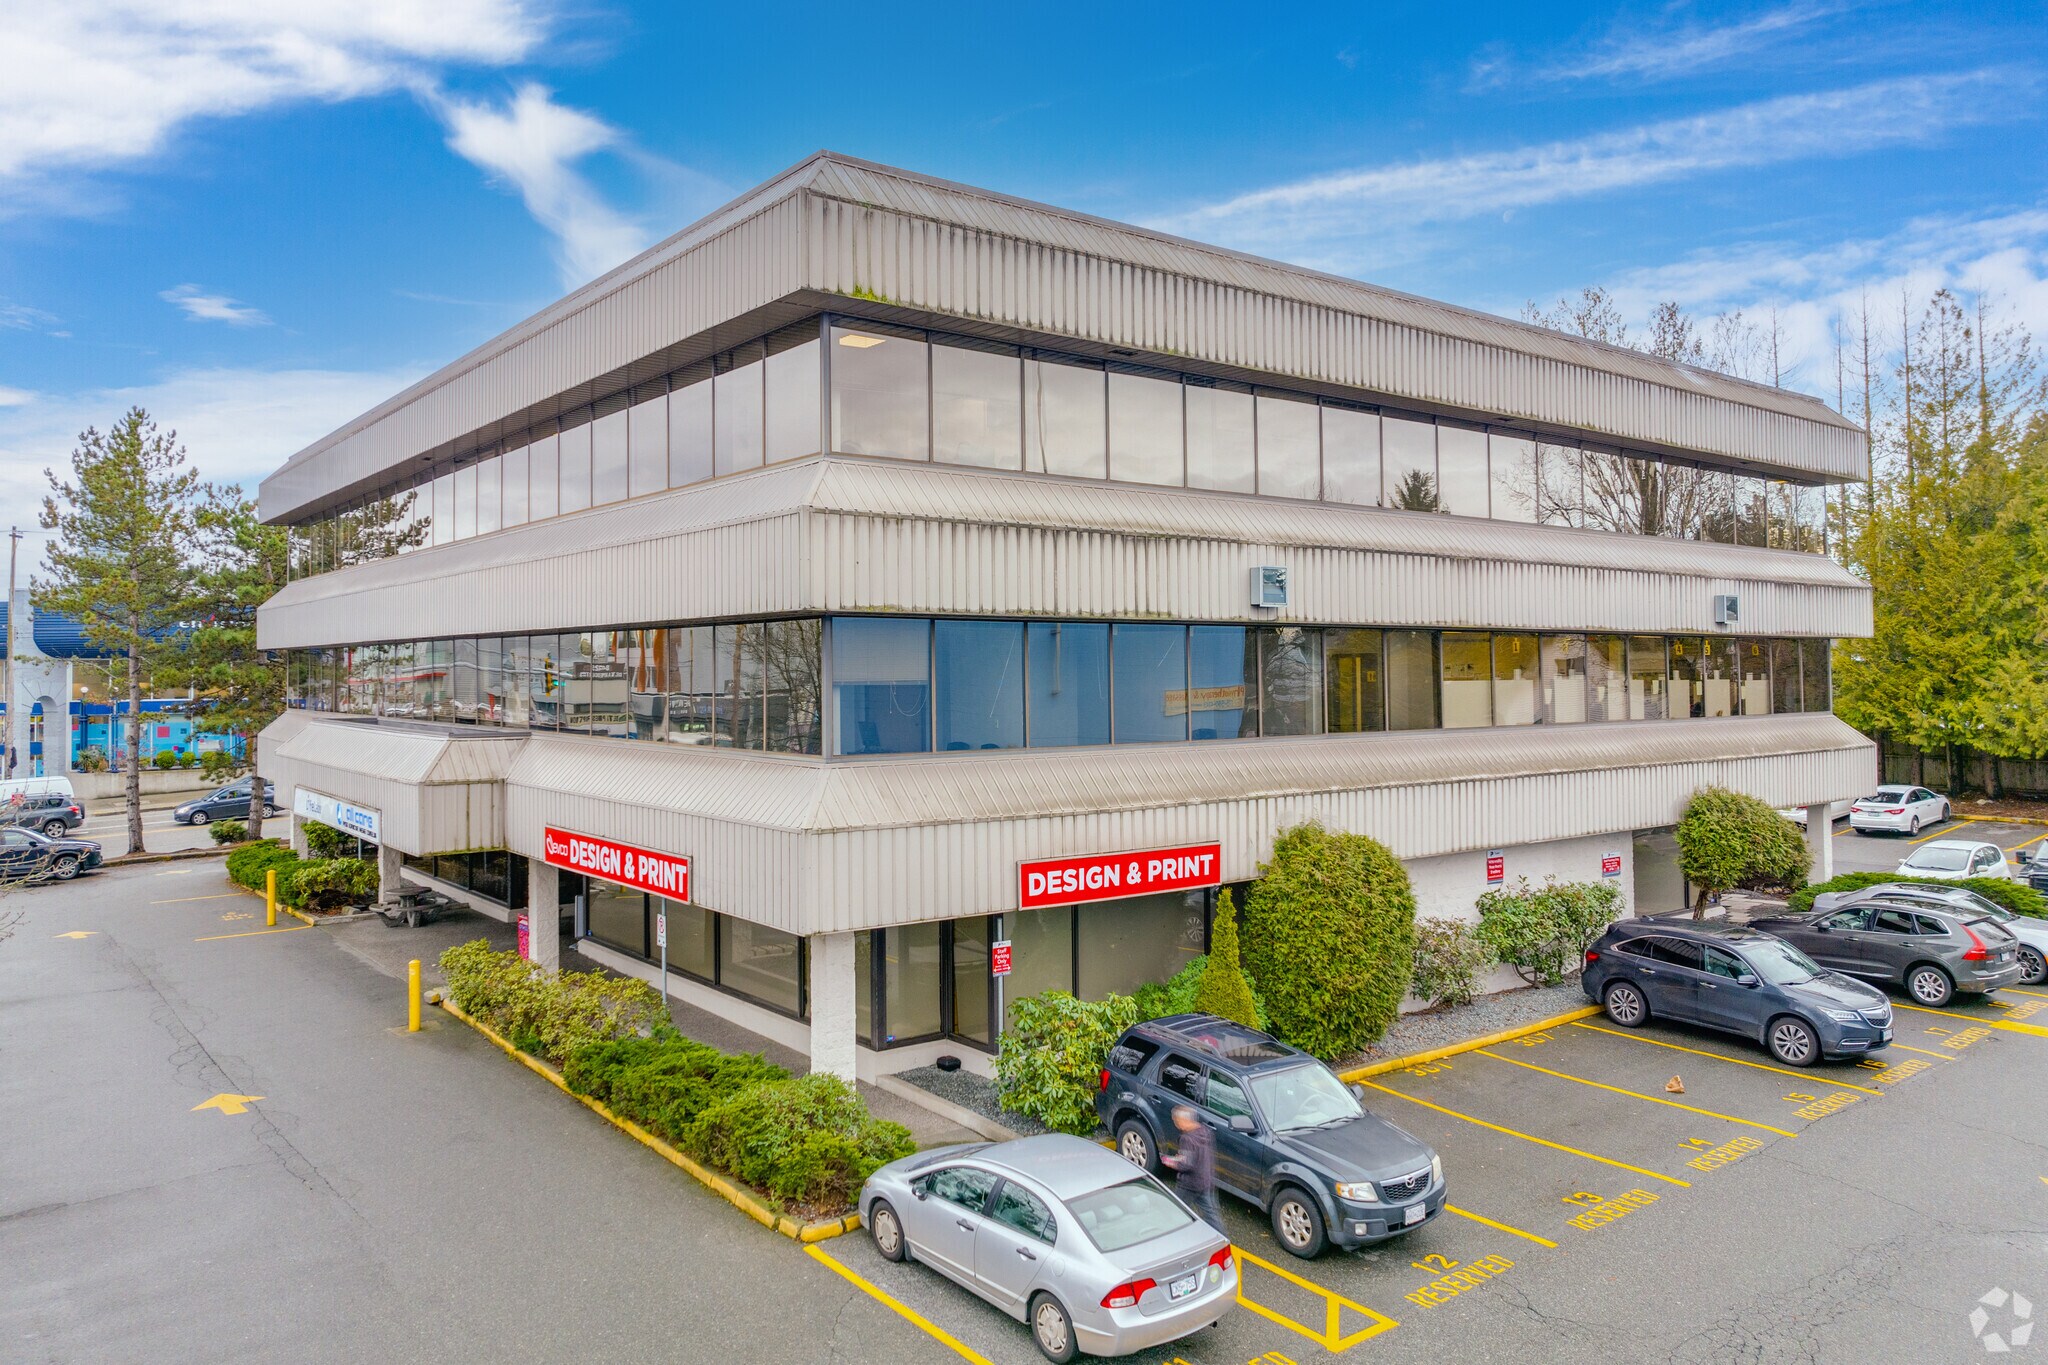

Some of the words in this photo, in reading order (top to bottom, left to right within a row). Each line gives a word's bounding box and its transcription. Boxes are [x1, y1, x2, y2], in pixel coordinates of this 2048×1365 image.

[569, 838, 621, 876] DESIGN
[624, 852, 635, 879] &
[638, 856, 687, 893] PRINT
[1028, 864, 1120, 896] DESIGN
[1126, 862, 1142, 884] &
[1148, 854, 1214, 882] PRINT
[1923, 1026, 1953, 1036] 17
[1855, 1059, 1889, 1071] 16
[1870, 1058, 1933, 1085] RESERVED
[1782, 1092, 1816, 1104] 15
[1791, 1091, 1861, 1121] RESERVED
[1677, 1137, 1714, 1151] 14
[1686, 1136, 1764, 1172] RESERVED
[1562, 1191, 1604, 1207] 13
[1566, 1188, 1660, 1231] RESERVED
[1411, 1253, 1459, 1274] 12
[1404, 1253, 1515, 1309] RESERVED
